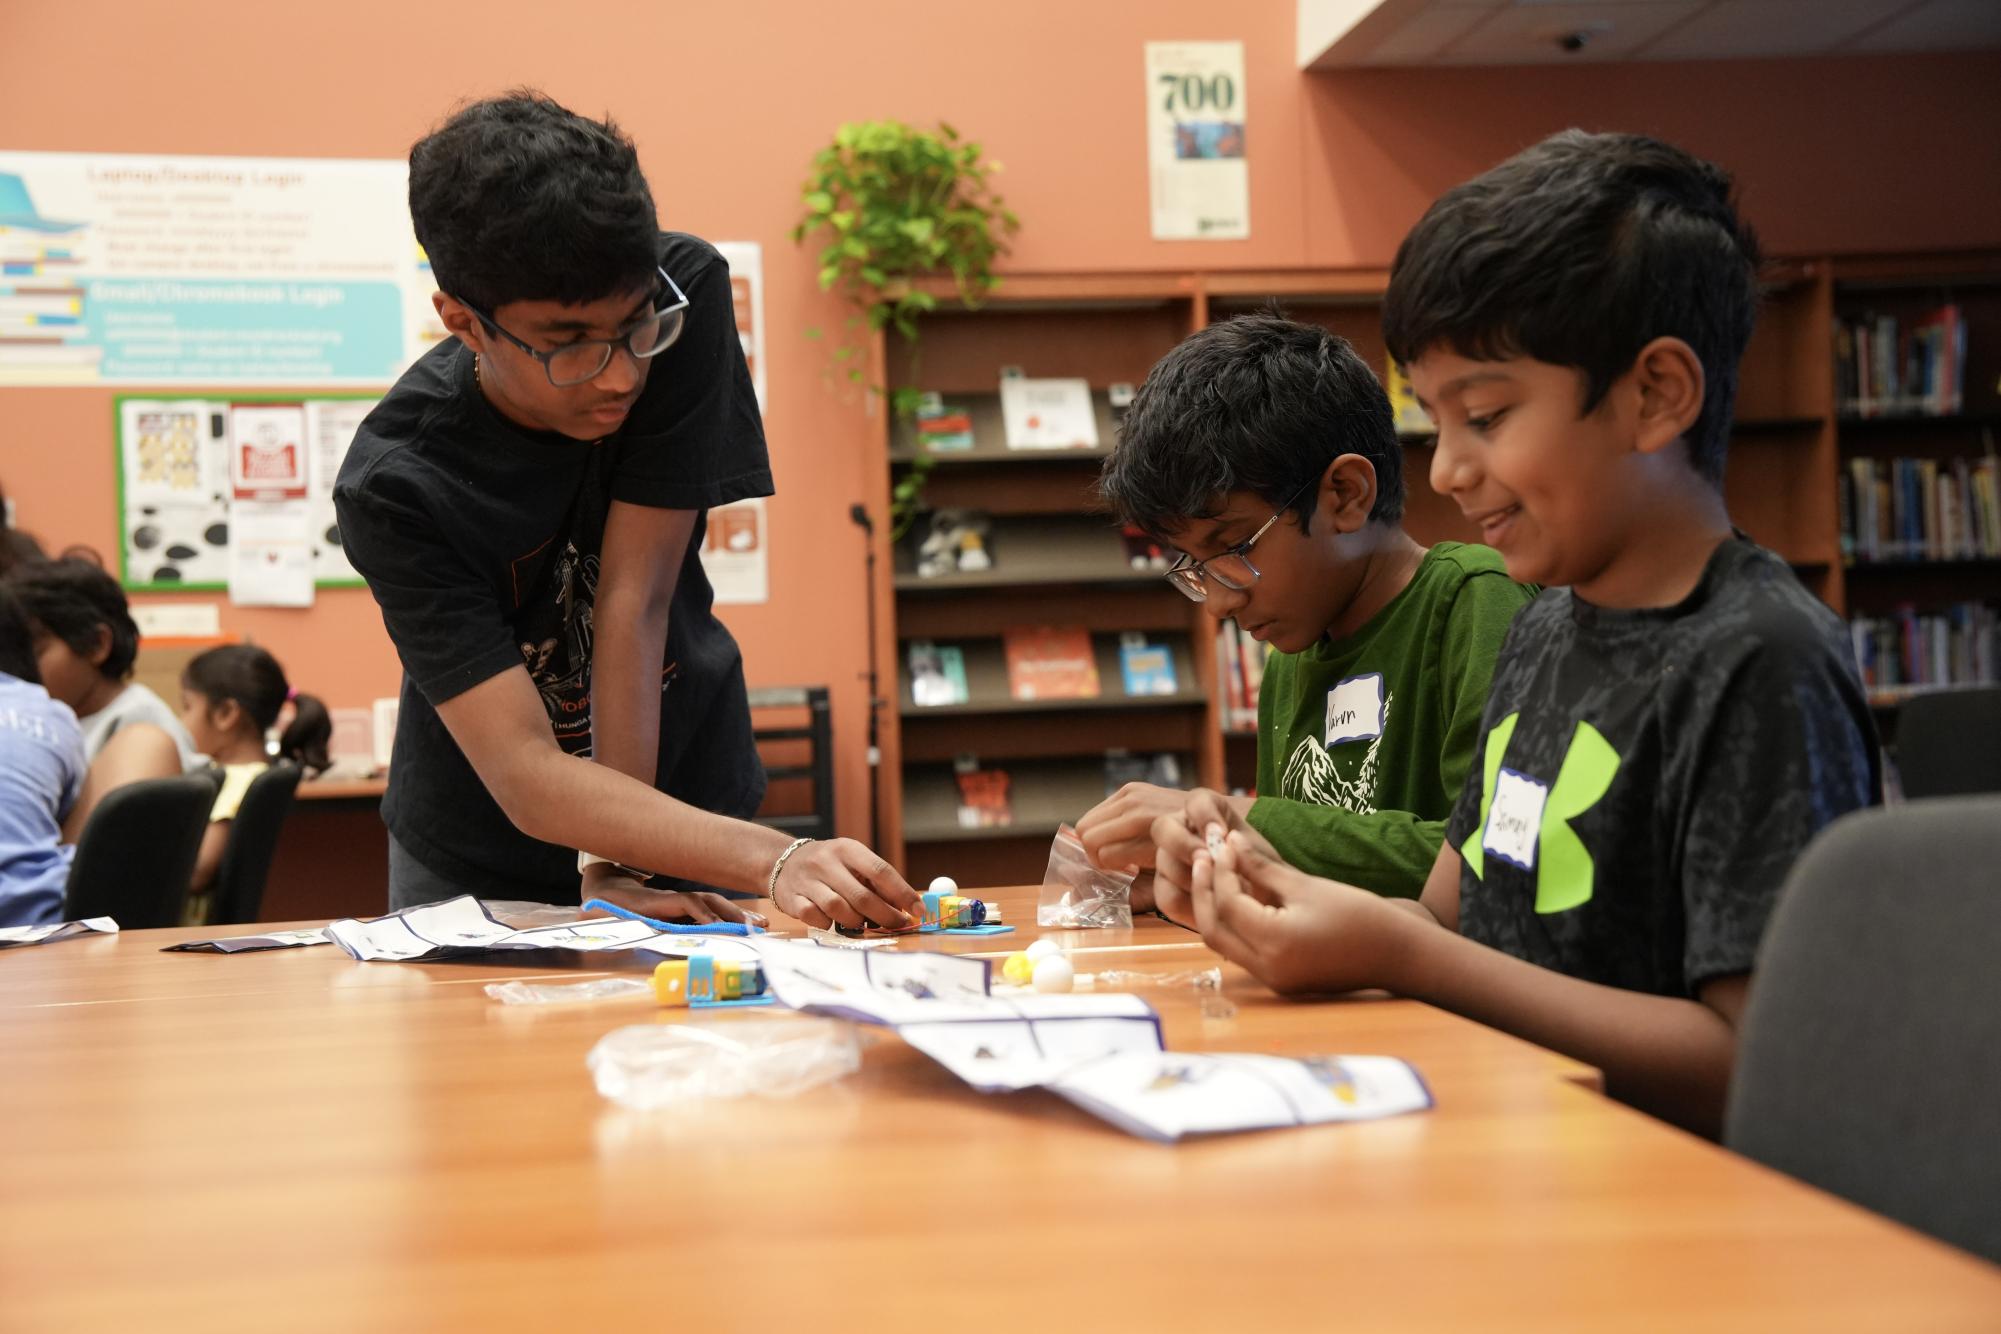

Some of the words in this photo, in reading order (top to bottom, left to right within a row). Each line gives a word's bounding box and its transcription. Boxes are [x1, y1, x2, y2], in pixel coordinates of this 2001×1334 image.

[1158, 72, 1235, 112] 700
[252, 169, 305, 189] Login
[289, 283, 346, 308] Login
